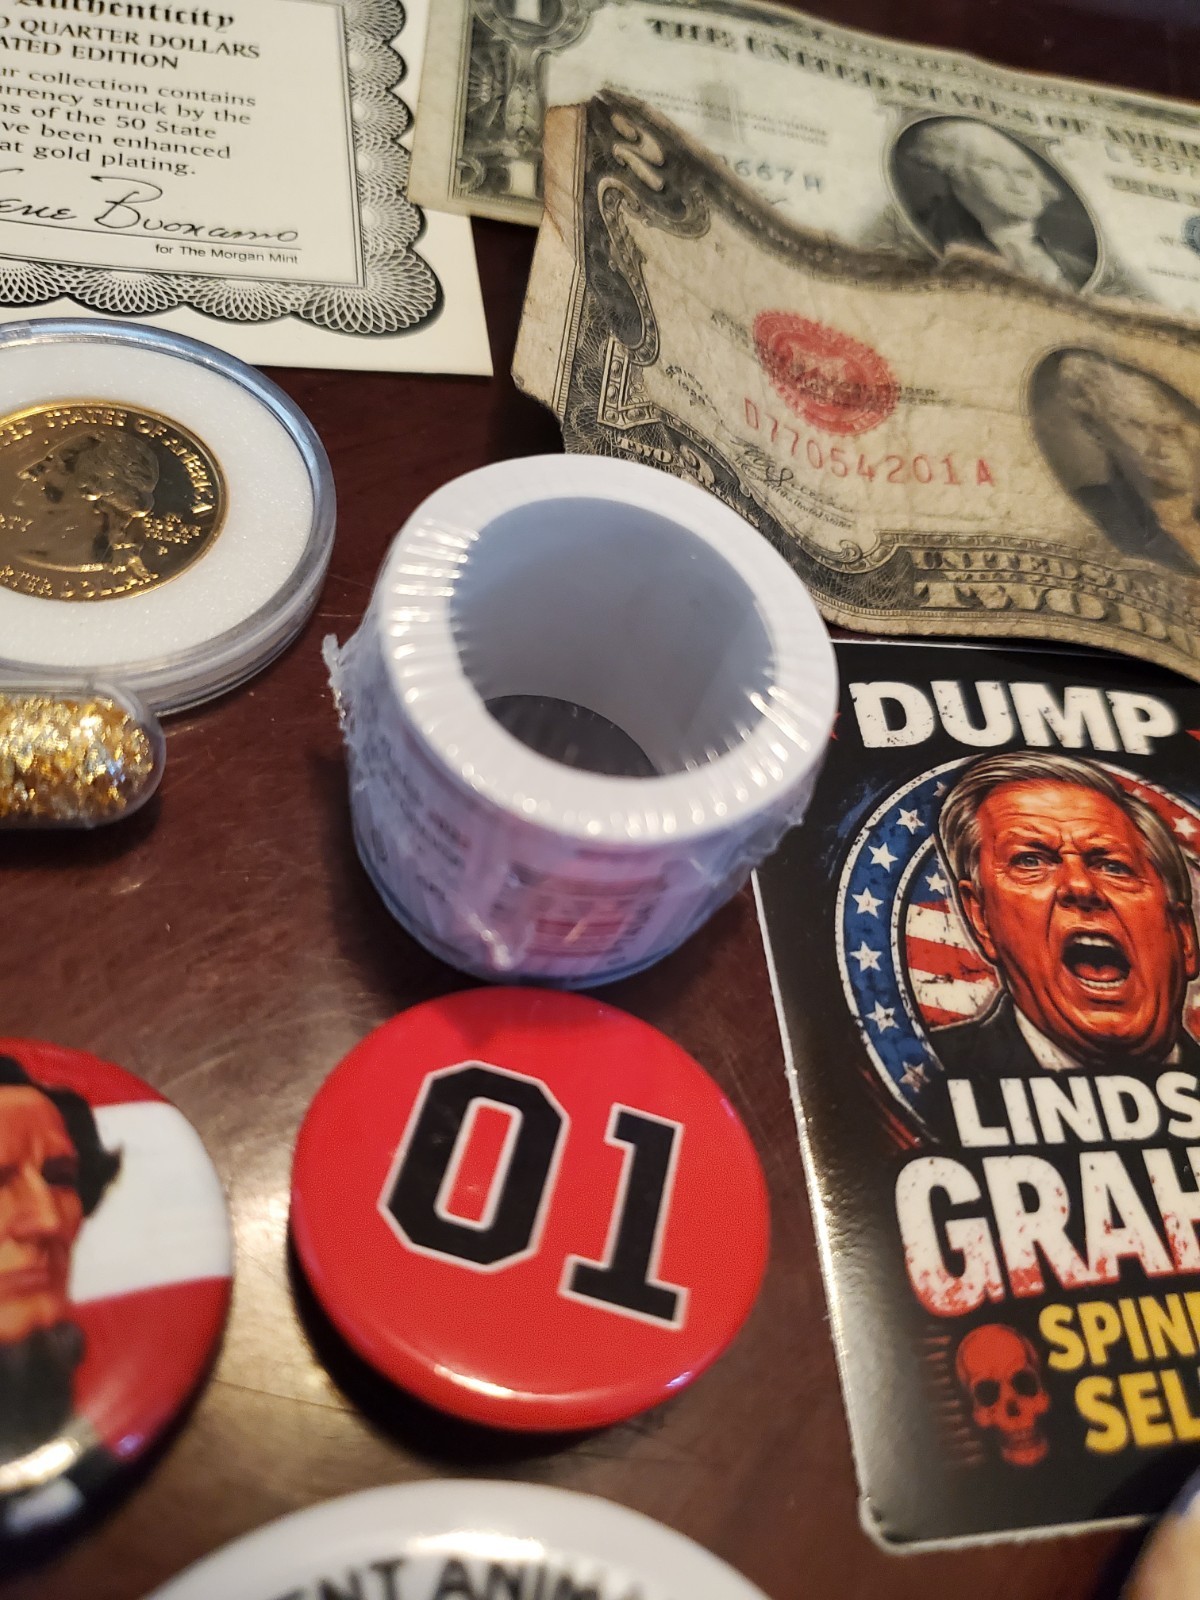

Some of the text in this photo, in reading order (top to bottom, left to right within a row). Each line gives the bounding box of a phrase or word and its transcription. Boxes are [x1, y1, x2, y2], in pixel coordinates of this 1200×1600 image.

[21, 18, 140, 46] QUARTER
[150, 33, 261, 59] DOLLARS
[72, 44, 179, 71] EDITION
[28, 72, 148, 95] collection
[158, 86, 257, 108] contains
[31, 106, 61, 120] of
[66, 110, 107, 127] the
[116, 115, 147, 131] 50
[155, 120, 218, 140] State
[93, 95, 168, 116] struck
[177, 103, 205, 122] by
[214, 109, 252, 126] the
[41, 123, 103, 145] been
[113, 136, 232, 160] enhanced
[33, 145, 91, 163] gold
[101, 152, 197, 177] plating.
[155, 243, 300, 265] for The Morgan Mint
[135, 417, 168, 439] OF
[743, 395, 996, 487] D77054201A
[849, 680, 1180, 756] DUMP
[947, 1071, 1200, 1148] LINDS
[377, 1060, 690, 1331] 01
[895, 1147, 1200, 1318] GRAH
